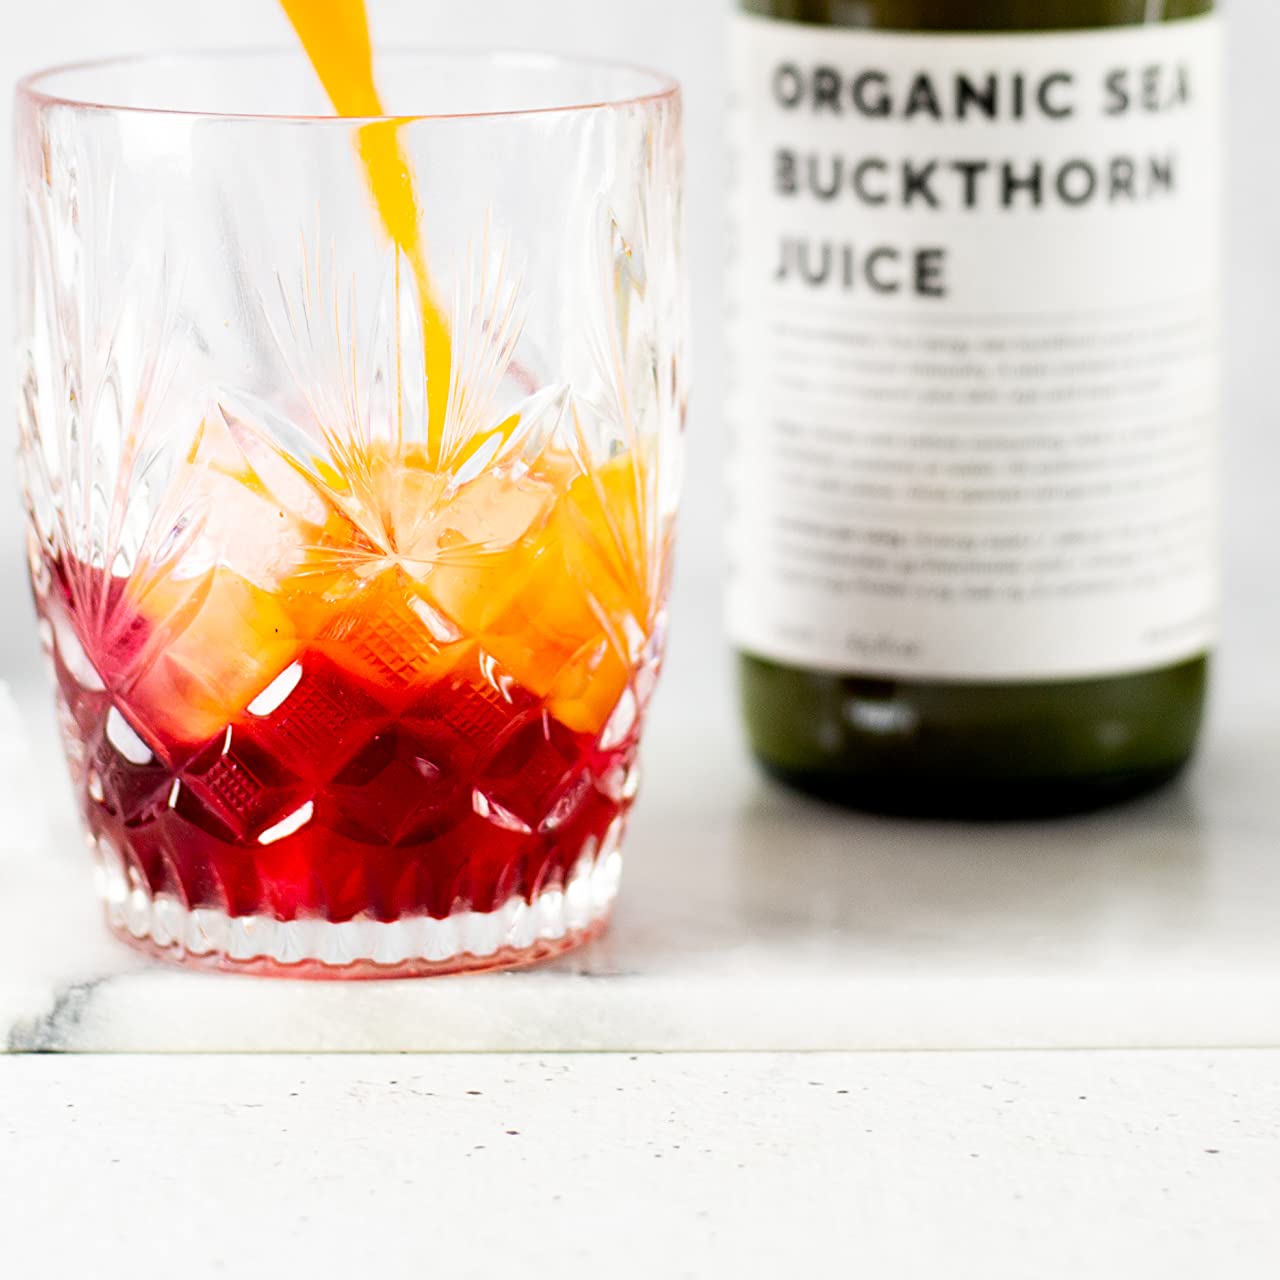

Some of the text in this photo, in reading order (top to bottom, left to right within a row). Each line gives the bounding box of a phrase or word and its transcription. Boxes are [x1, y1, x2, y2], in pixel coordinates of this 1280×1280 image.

[773, 62, 1191, 119] ORGANIC SEA
[775, 150, 1178, 209] BUCKTHORN
[775, 237, 949, 297] JUICE
